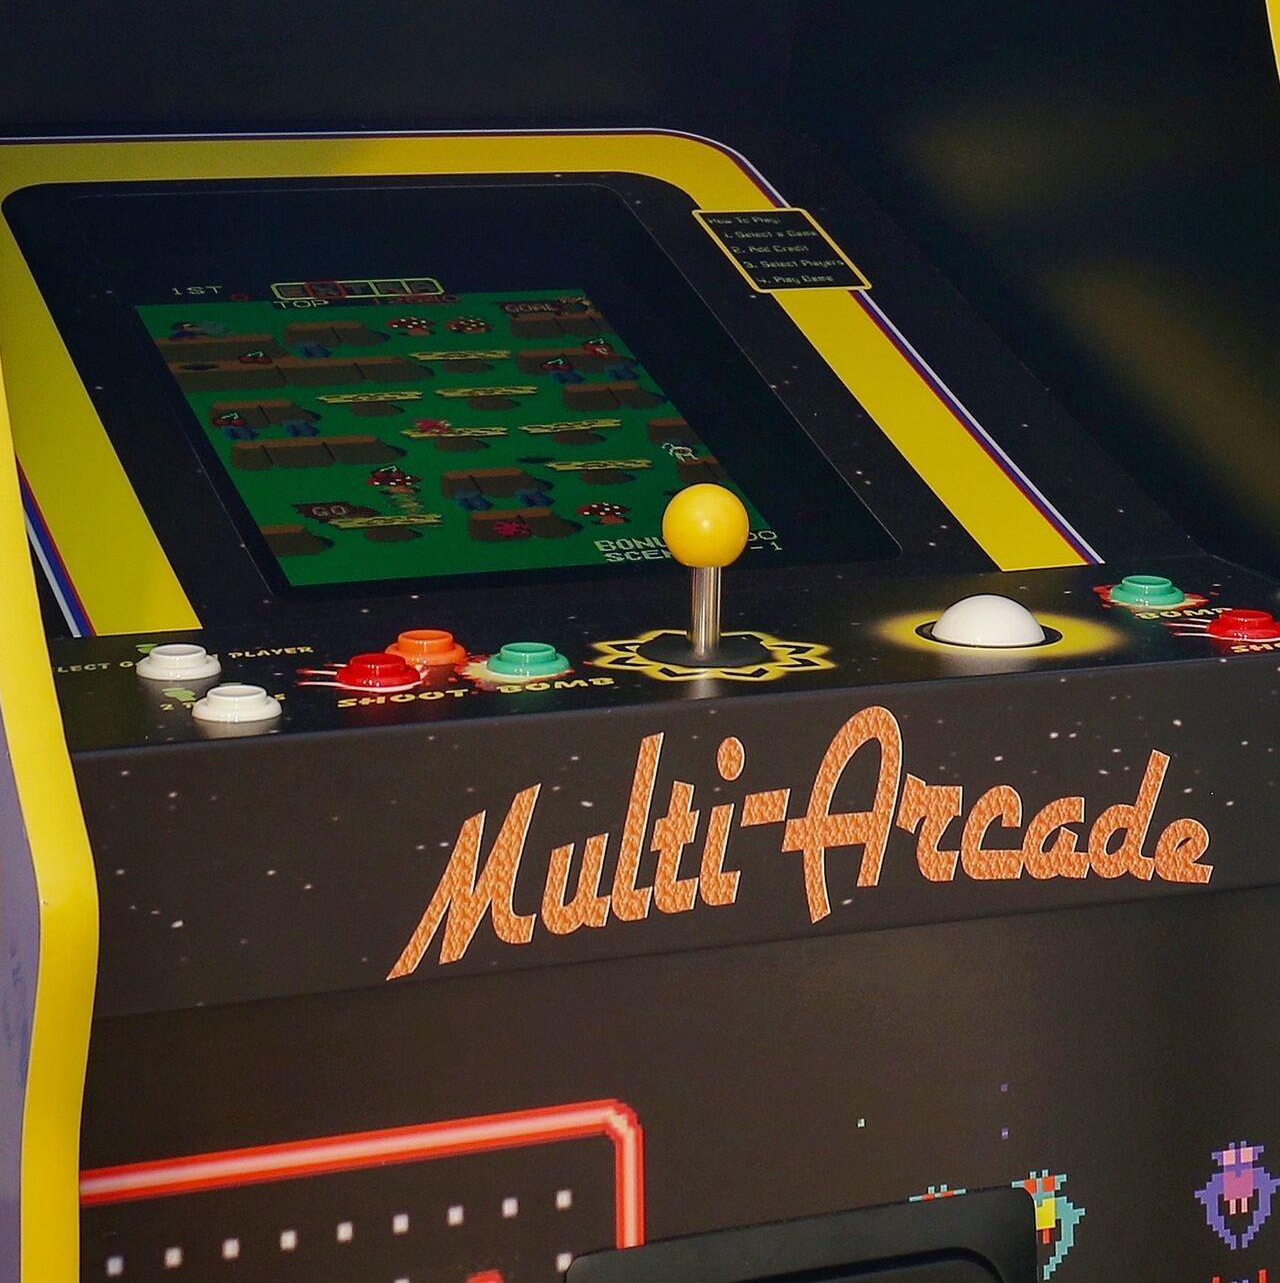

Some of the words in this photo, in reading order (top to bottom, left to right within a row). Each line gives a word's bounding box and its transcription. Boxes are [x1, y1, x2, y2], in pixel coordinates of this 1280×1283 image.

[786, 229, 818, 238] Game
[772, 245, 809, 253] Credit
[759, 260, 799, 268] Select
[800, 259, 844, 268] Players
[772, 276, 801, 285] Play
[801, 275, 834, 283] Game
[171, 285, 222, 296] 1ST
[272, 298, 330, 310] TOP
[311, 505, 347, 517] GO
[228, 645, 315, 660] PLAYER
[496, 676, 616, 695] BOMB
[336, 688, 469, 708] SHOOT
[385, 704, 1213, 981] Multi-Arcade
